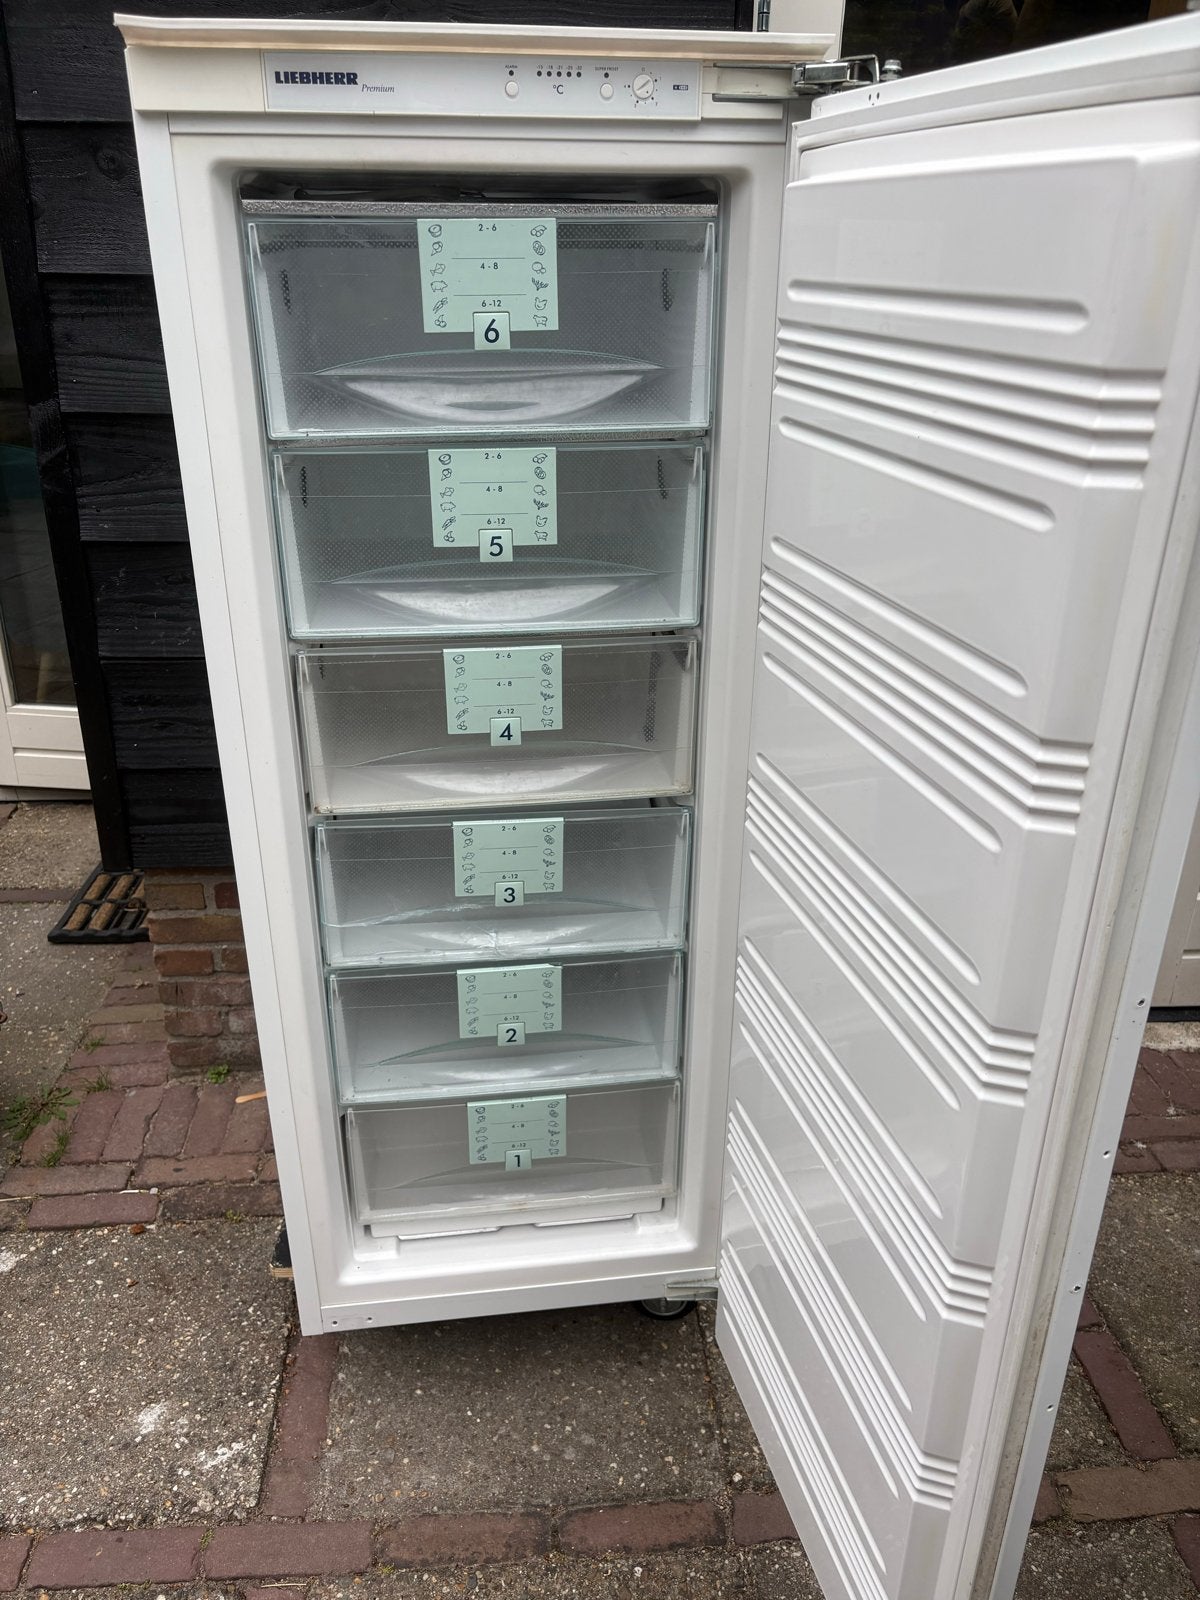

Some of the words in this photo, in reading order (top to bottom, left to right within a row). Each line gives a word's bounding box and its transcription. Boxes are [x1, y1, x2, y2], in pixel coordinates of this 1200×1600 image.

[274, 71, 358, 86] LIEBHERR
[361, 84, 395, 93] Premium
[484, 318, 500, 343] 6
[489, 536, 504, 557] 5
[499, 723, 513, 740] 4
[504, 887, 515, 903] 3
[506, 1028, 517, 1042] 2
[514, 1155, 520, 1167] 1
